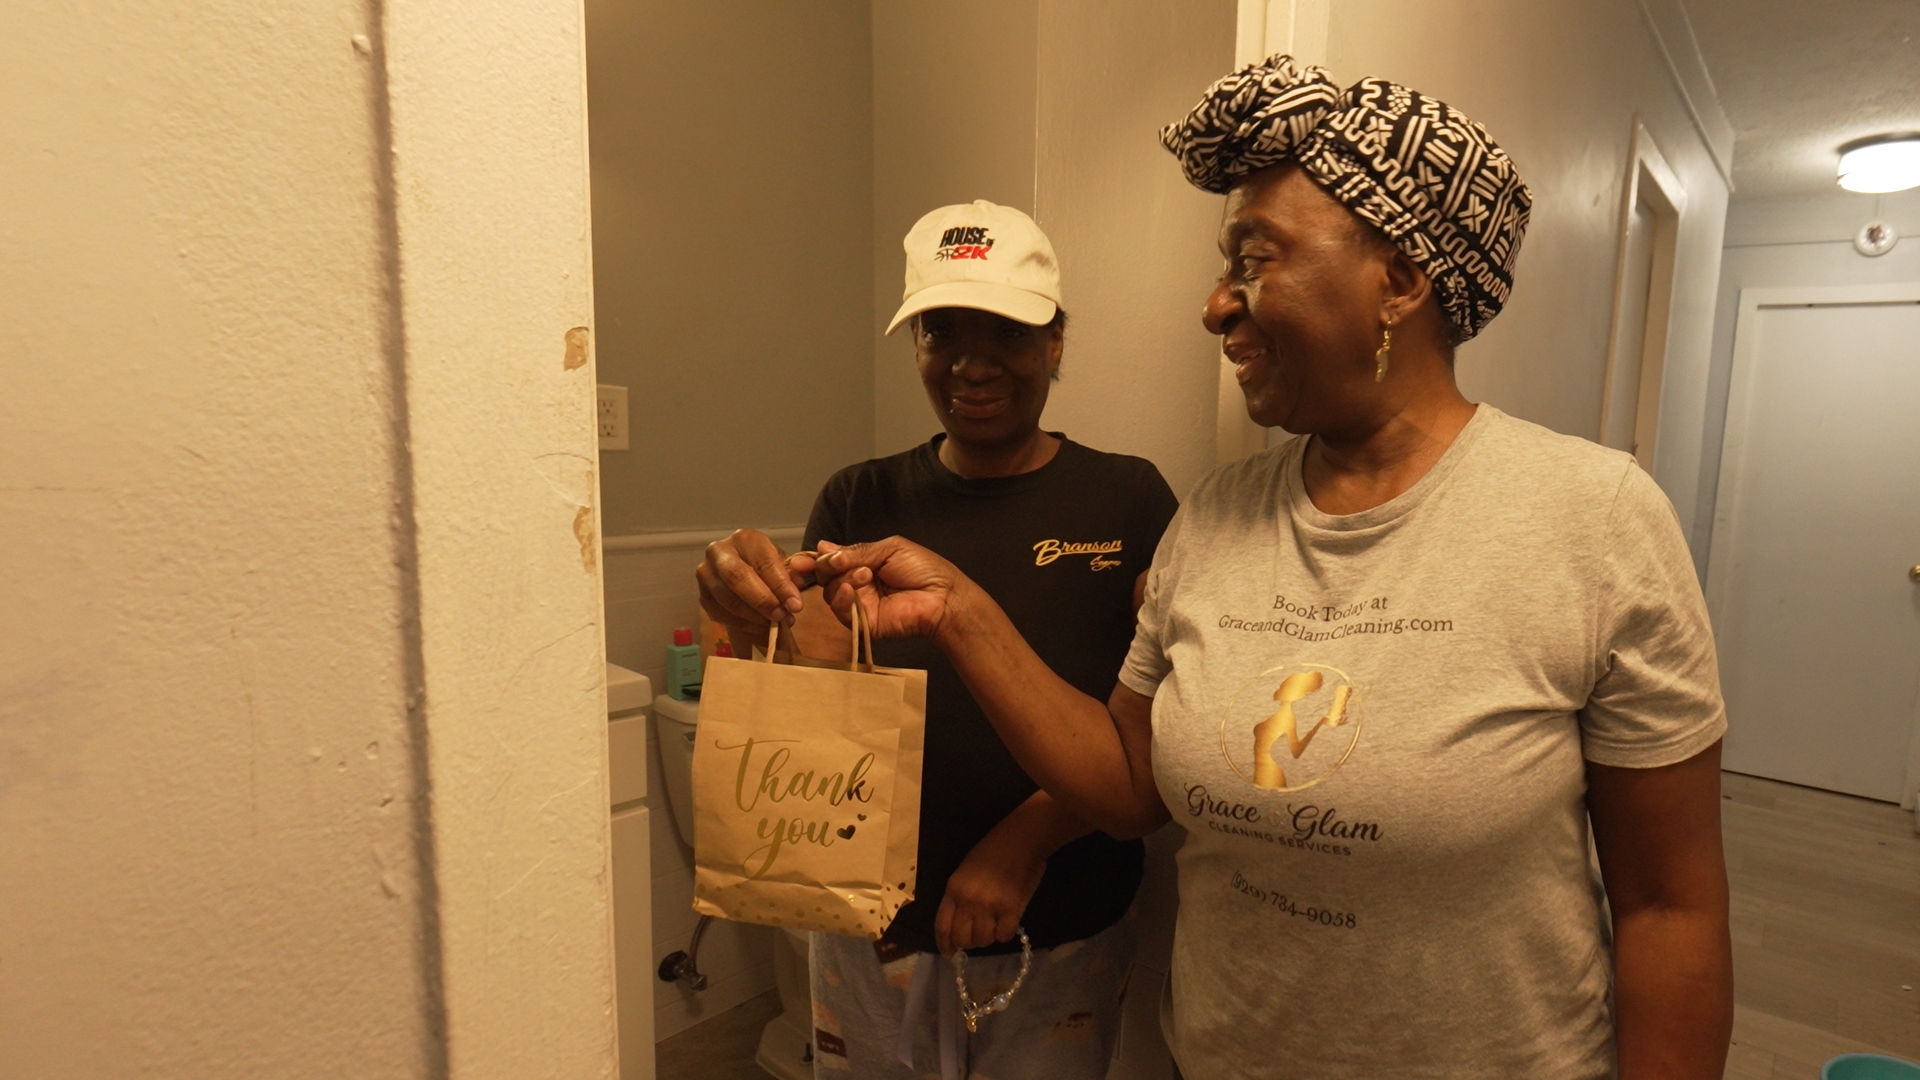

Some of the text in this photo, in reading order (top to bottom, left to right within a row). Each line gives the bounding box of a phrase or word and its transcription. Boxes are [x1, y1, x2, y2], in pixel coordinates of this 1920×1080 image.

[939, 227, 990, 249] HOUSE
[951, 245, 992, 261] 2K
[1033, 539, 1123, 566] Branson
[1272, 595, 1389, 622] Book Today at
[1218, 614, 1454, 643] GraceandGlamCleaning.com
[1184, 782, 1261, 823] Grace
[1287, 804, 1384, 842] Glam
[743, 817, 835, 880] you
[1208, 820, 1352, 857] CLEANING SERVICES
[1230, 870, 1357, 929] (929) 734-9058
